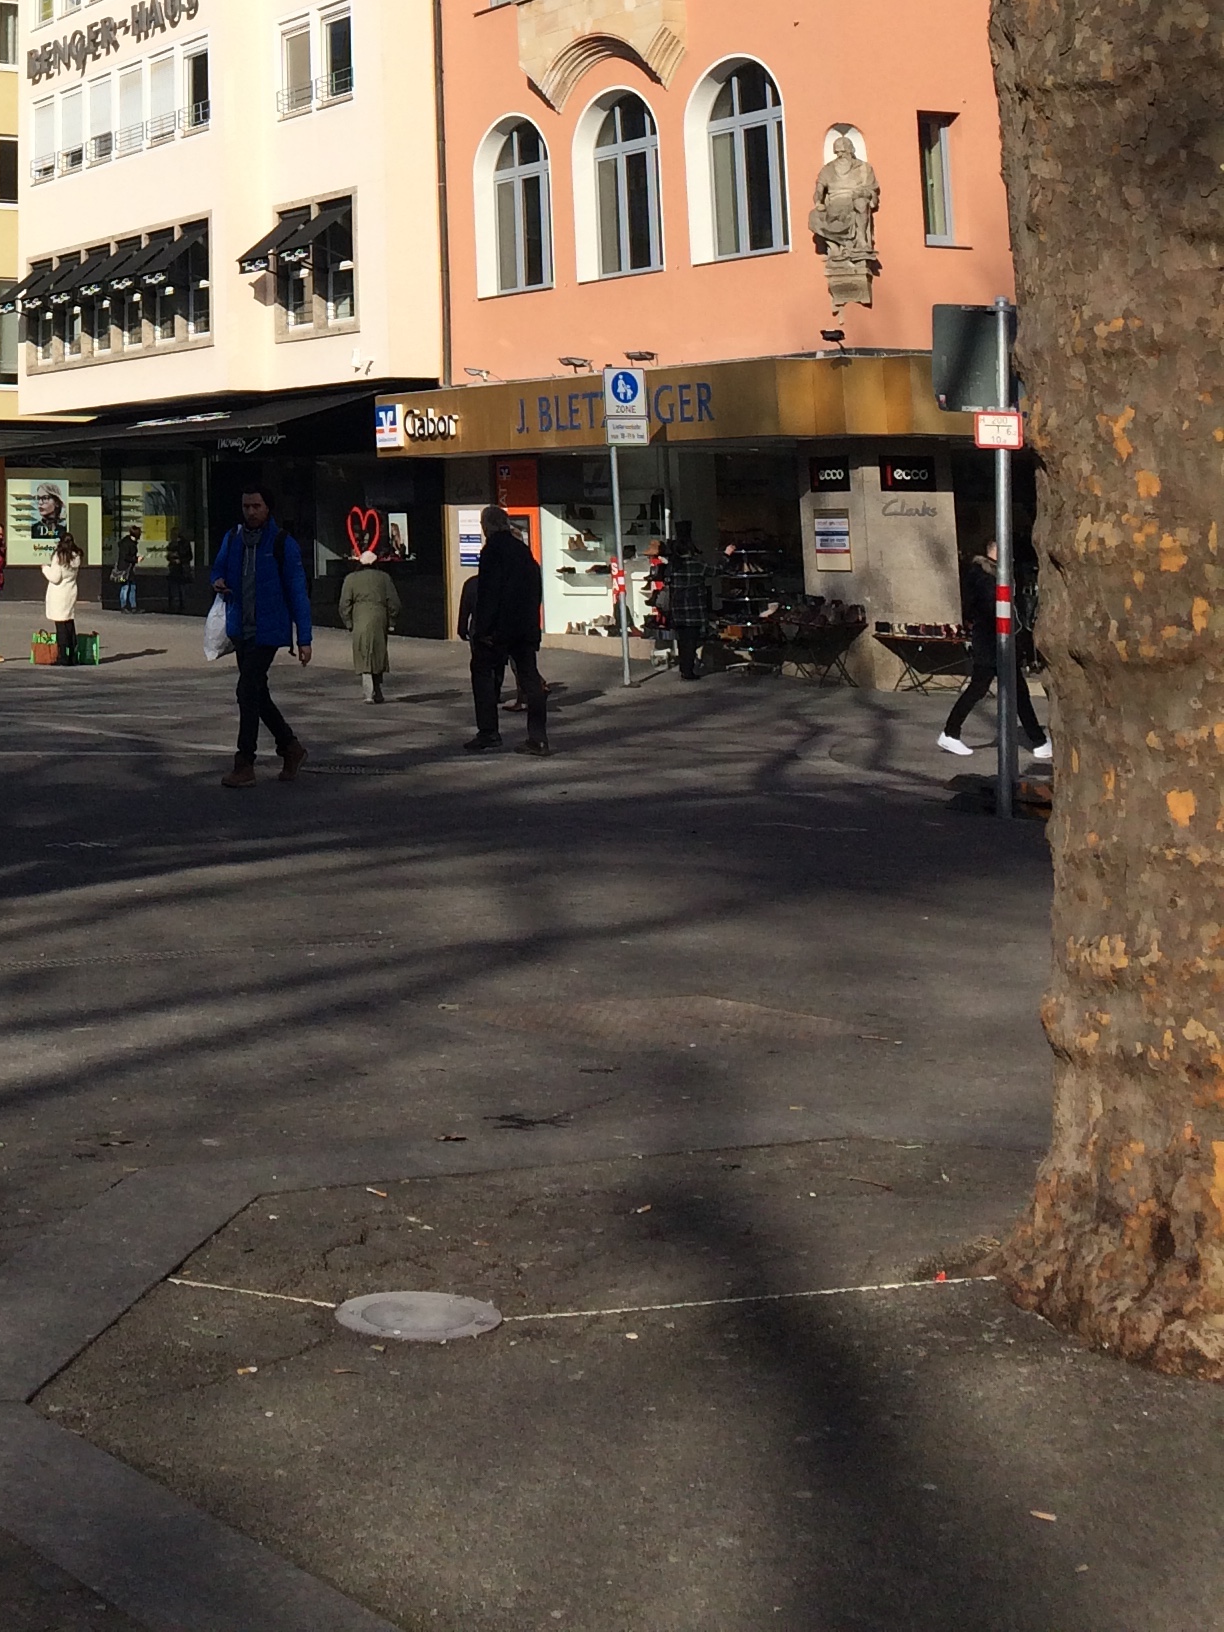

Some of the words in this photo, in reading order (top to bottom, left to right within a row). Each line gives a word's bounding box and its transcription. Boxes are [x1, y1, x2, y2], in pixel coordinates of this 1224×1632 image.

[615, 405, 637, 414] ZONE
[516, 398, 530, 434] J.
[991, 417, 1008, 425] 200
[404, 408, 460, 440] Gabor
[818, 469, 845, 480] ecco
[893, 468, 929, 480] ecco
[882, 498, 938, 517] Clarks
